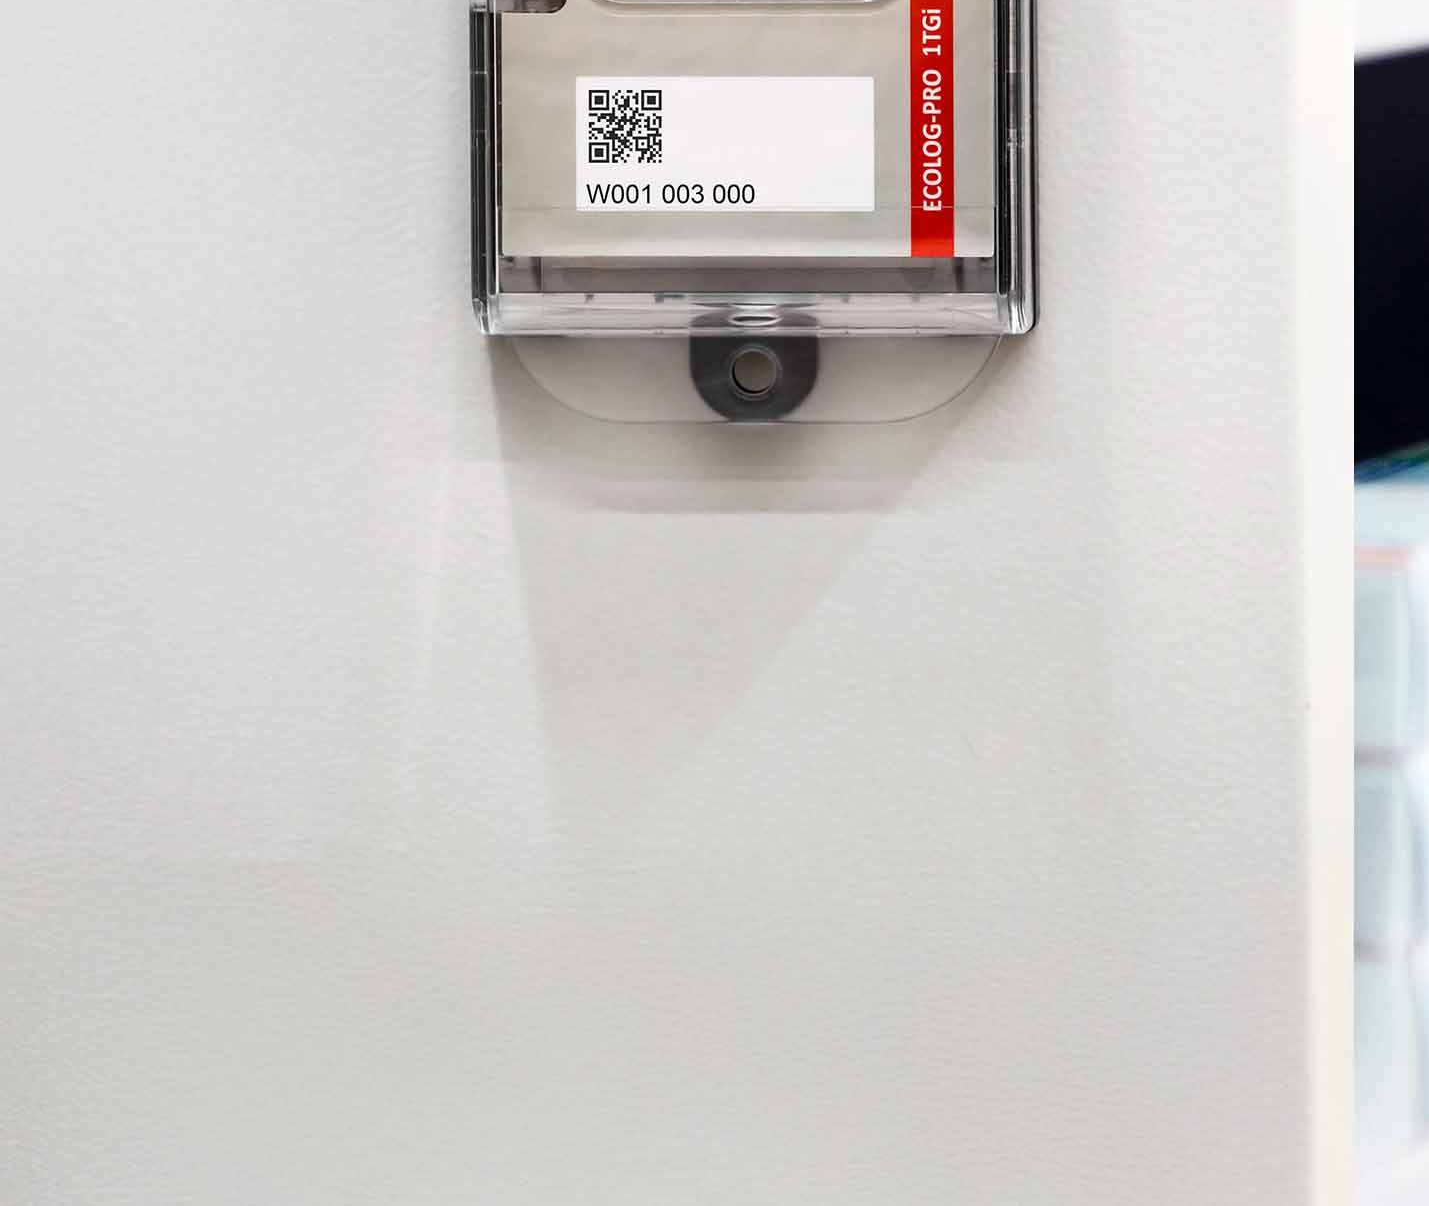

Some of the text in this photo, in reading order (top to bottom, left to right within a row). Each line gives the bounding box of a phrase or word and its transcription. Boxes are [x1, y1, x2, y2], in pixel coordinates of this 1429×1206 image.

[921, 8, 943, 212] ECOLOG-PRO 1TGi
[585, 183, 756, 205] W001 003 000
